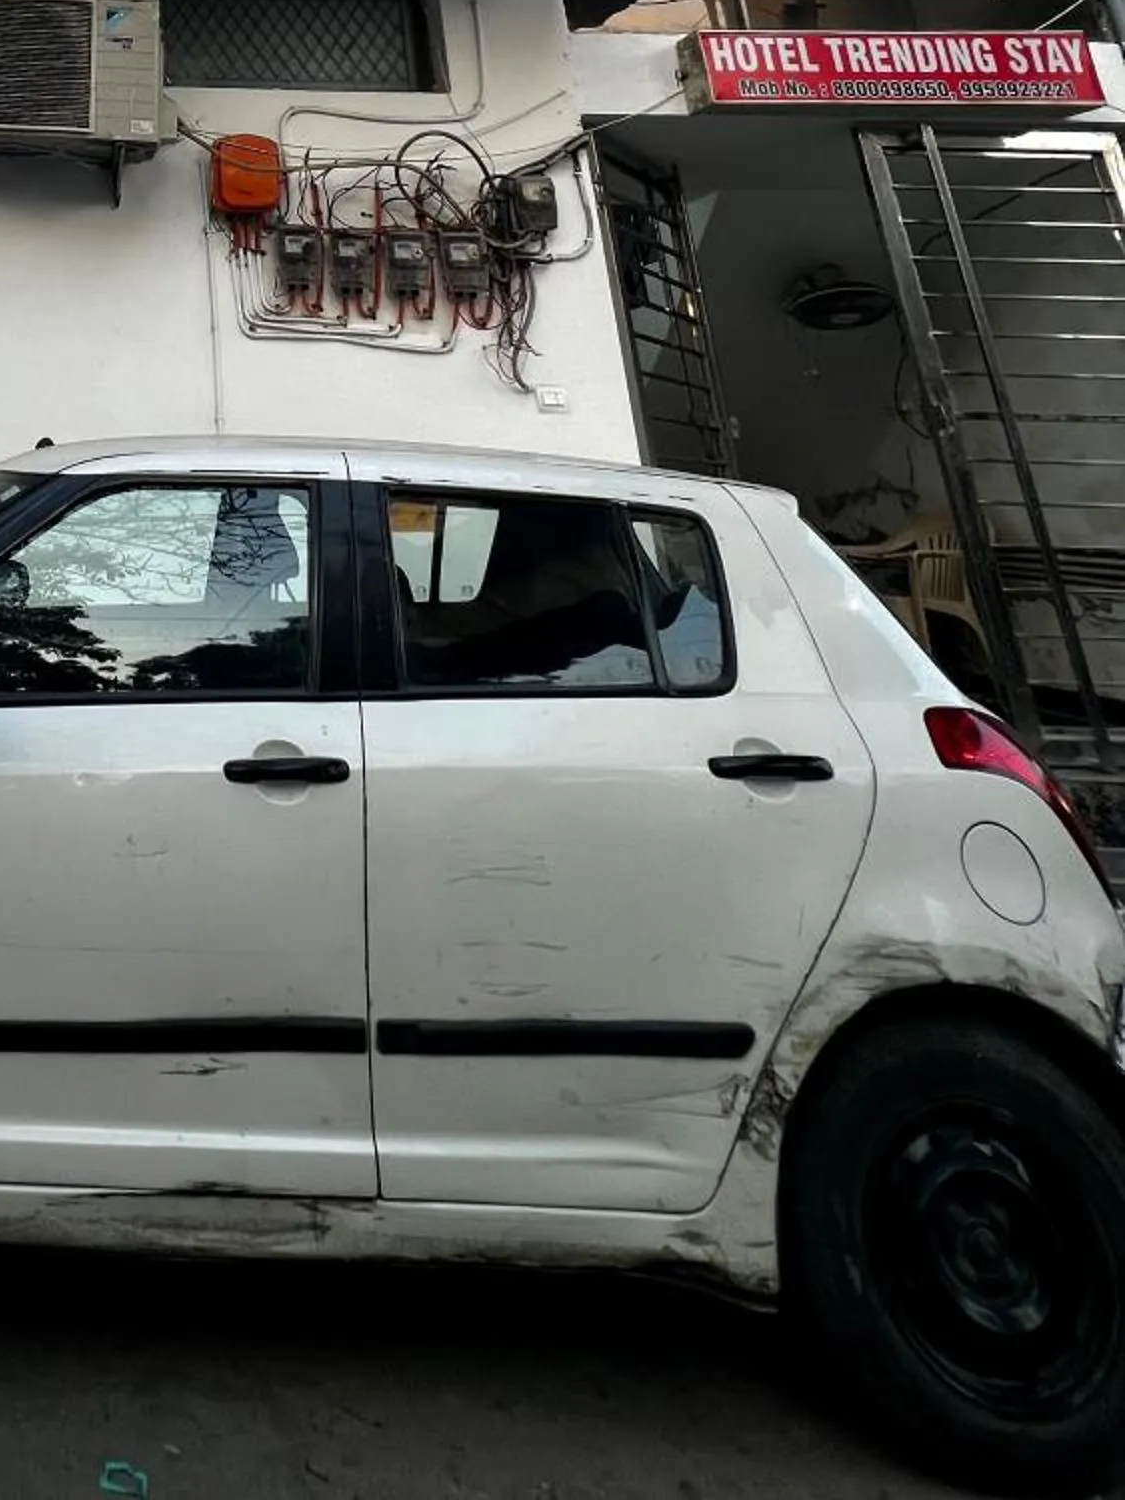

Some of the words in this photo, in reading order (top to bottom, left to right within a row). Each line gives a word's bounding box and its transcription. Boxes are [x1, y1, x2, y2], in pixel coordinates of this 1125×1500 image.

[708, 37, 820, 73] HOTEL
[823, 37, 998, 74] TRENDING
[1004, 37, 1084, 74] STAY
[739, 79, 780, 98] Mob
